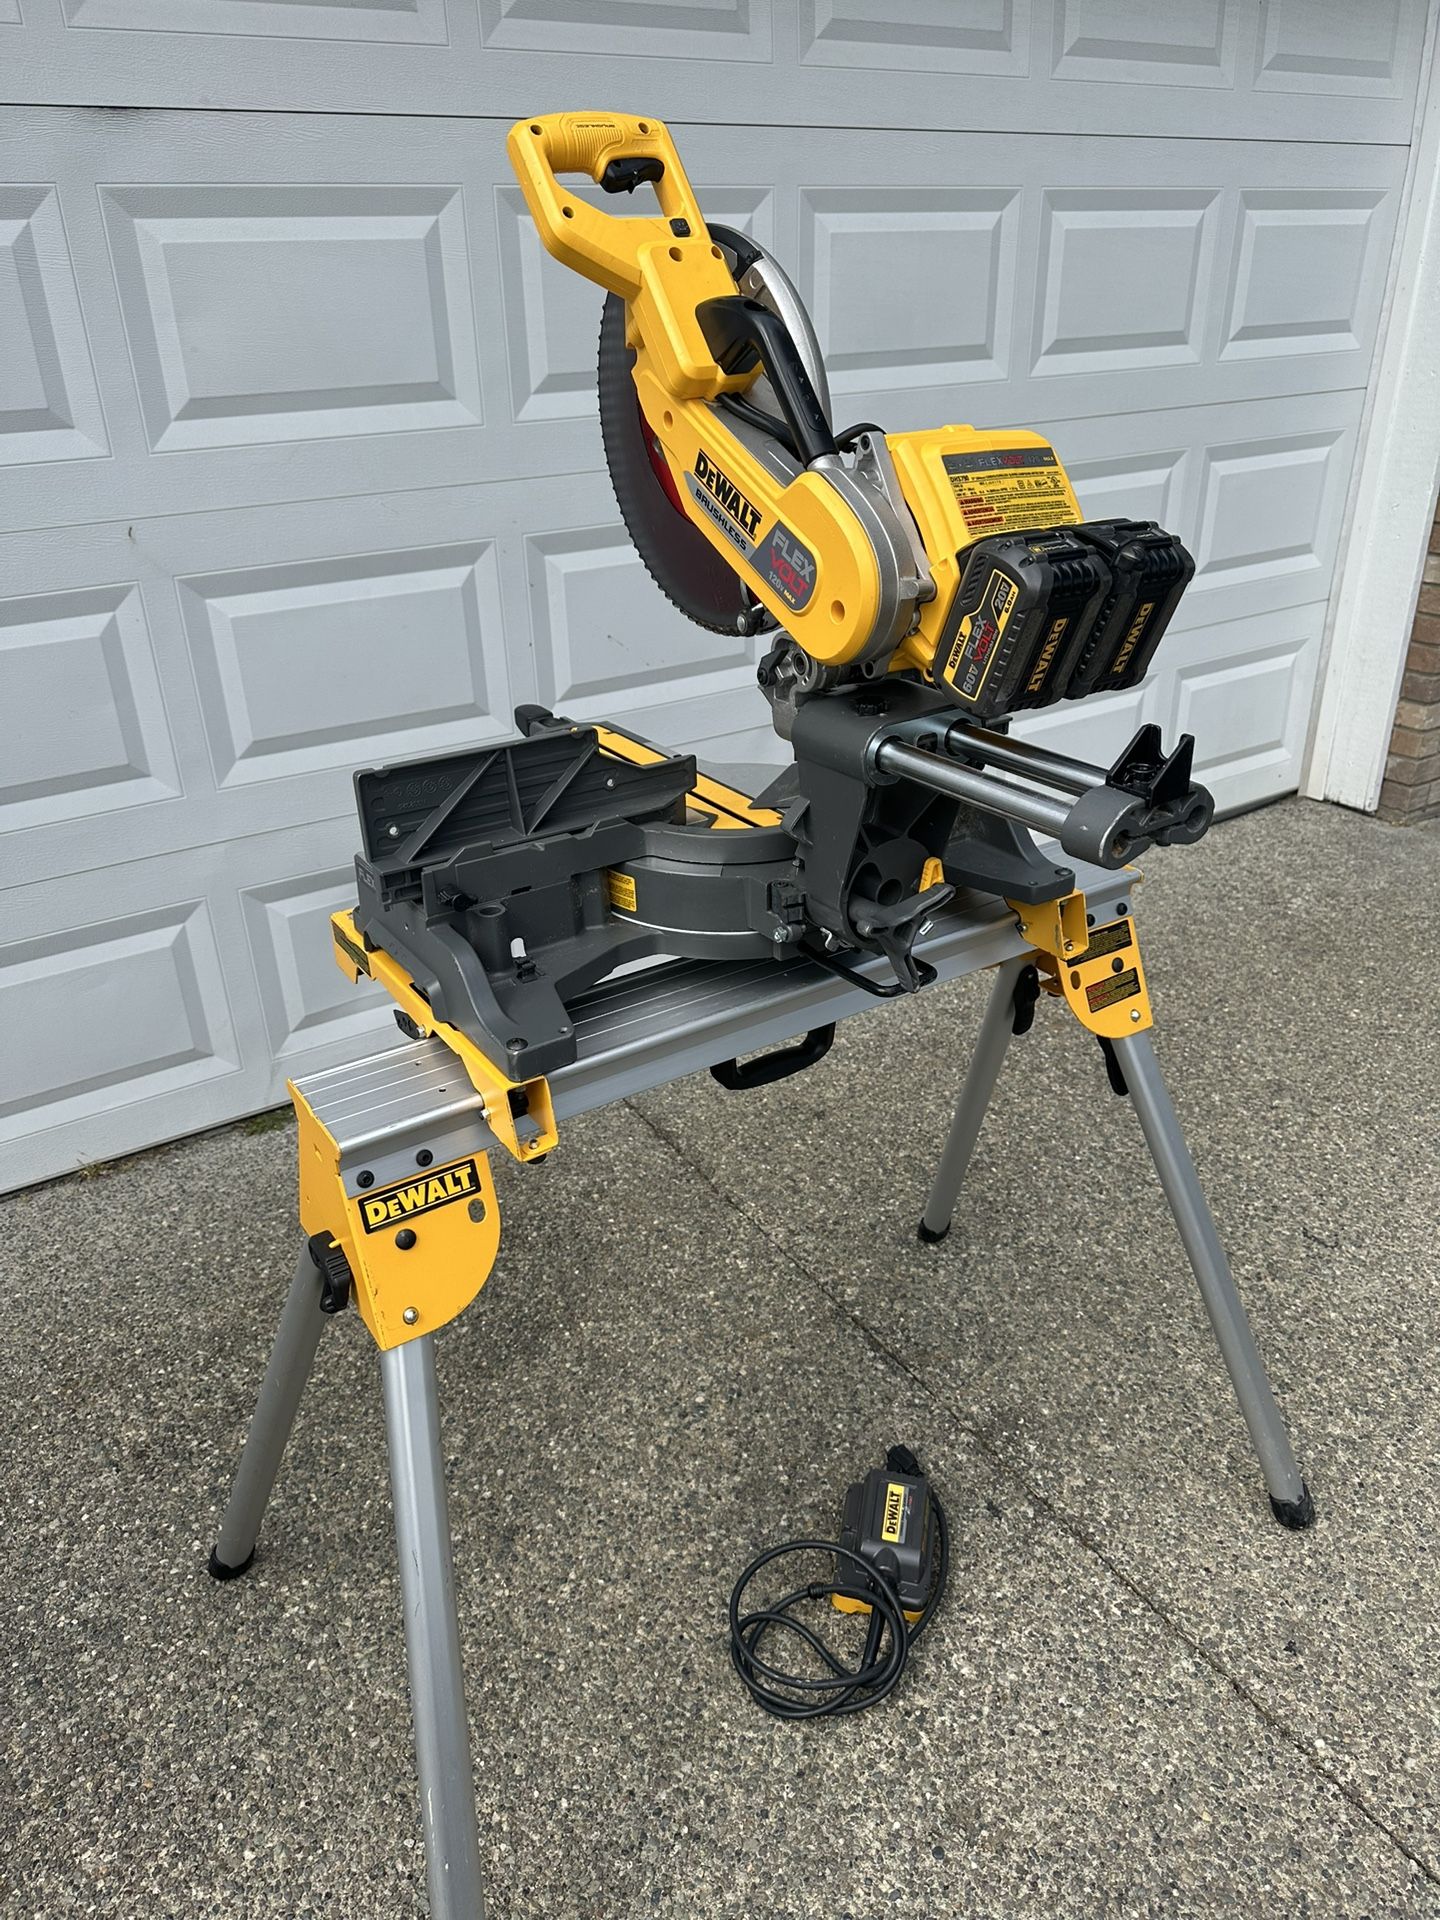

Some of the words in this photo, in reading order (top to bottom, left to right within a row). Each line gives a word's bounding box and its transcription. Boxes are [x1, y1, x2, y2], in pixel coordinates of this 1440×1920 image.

[695, 487, 748, 551] BRUSHLESS
[769, 547, 810, 598] VOLT
[771, 528, 816, 583] FLEX
[964, 615, 987, 660] FLEX
[973, 620, 996, 662] VOLT
[962, 664, 979, 694] 60V
